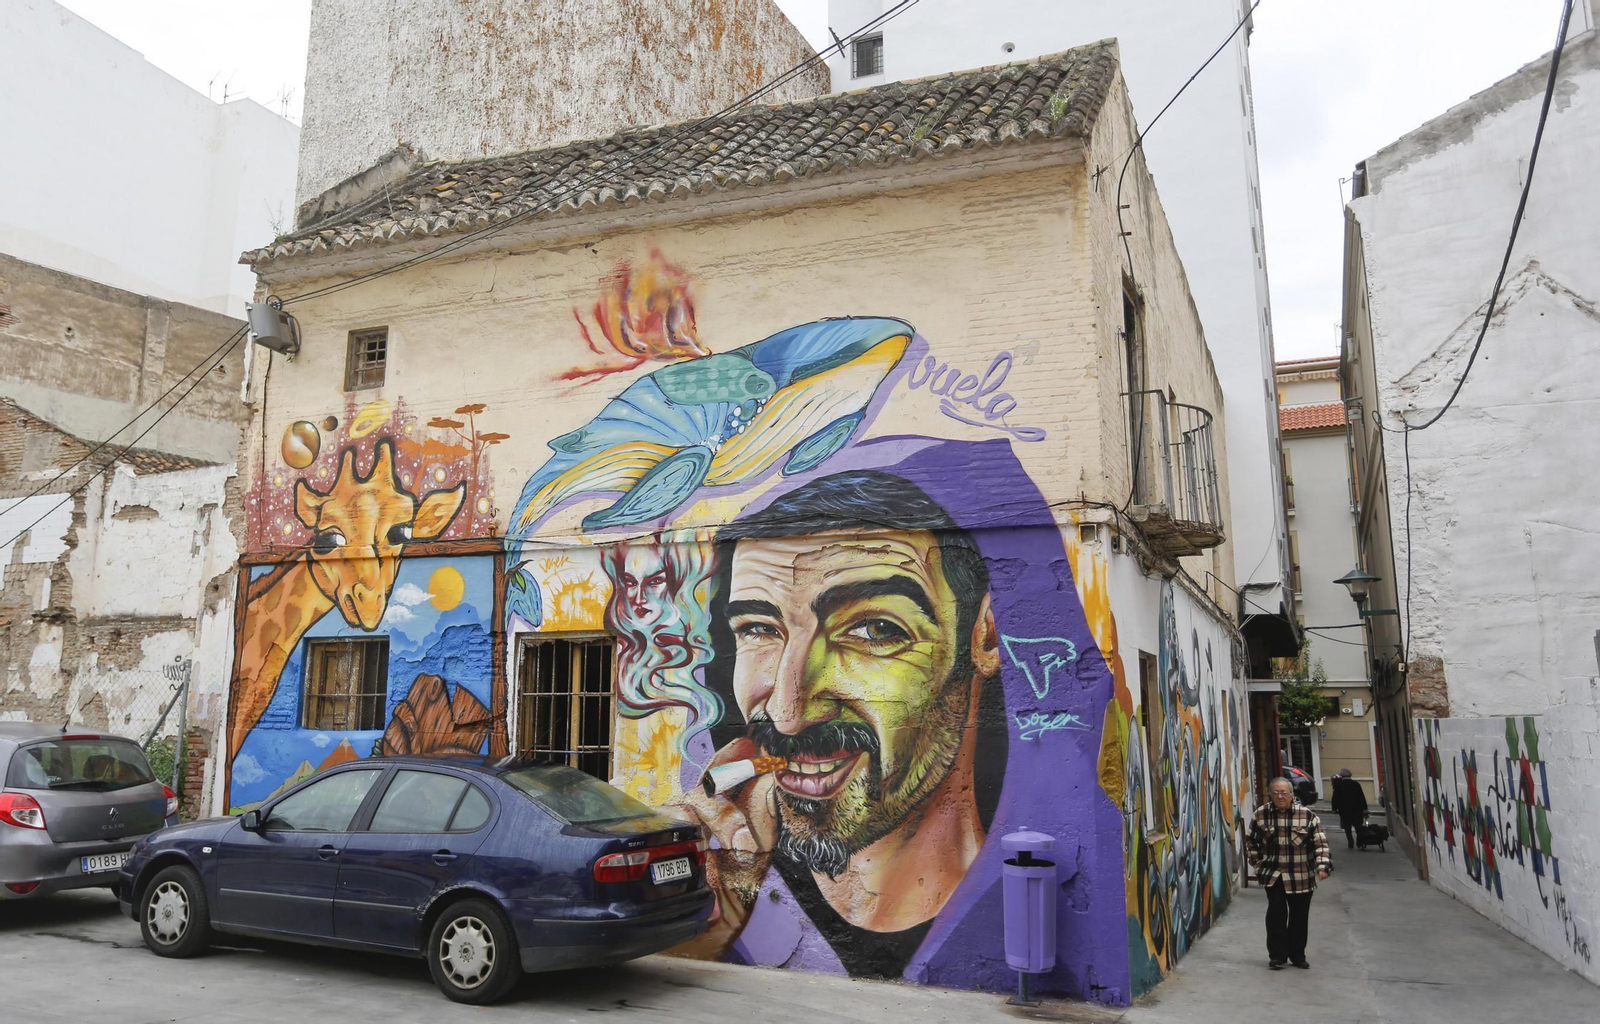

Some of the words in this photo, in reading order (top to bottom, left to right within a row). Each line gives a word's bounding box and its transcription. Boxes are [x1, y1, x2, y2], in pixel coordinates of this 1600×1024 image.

[90, 855, 117, 869] 0189
[657, 863, 675, 878] 1796
[676, 859, 688, 874] BZP
